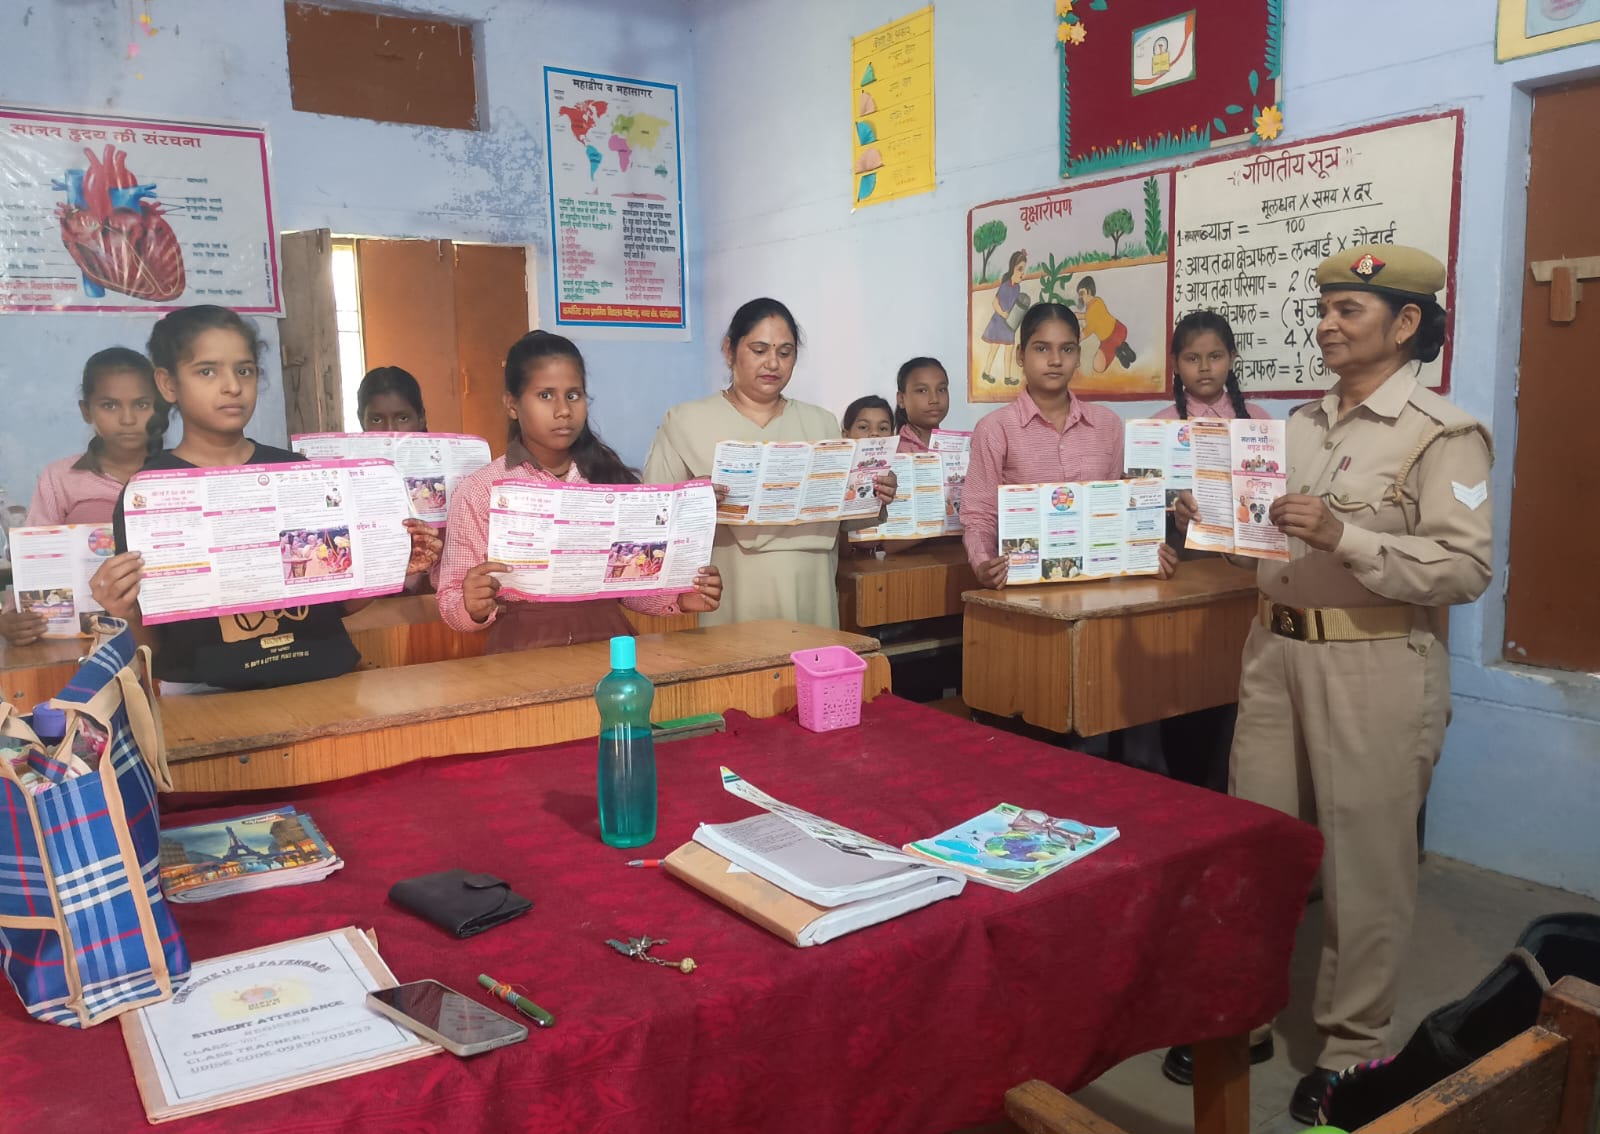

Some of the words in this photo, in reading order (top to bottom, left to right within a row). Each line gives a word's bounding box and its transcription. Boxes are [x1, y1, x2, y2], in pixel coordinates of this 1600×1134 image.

[572, 78, 603, 91] महाद्वीप
[606, 84, 613, 92] व
[616, 85, 653, 98] महासागर
[67, 127, 106, 143] हृदय
[112, 128, 136, 144] की
[143, 130, 202, 148] संरचना
[1242, 150, 1306, 184] गणितीय
[1308, 146, 1341, 179] सूत्र
[1261, 195, 1297, 219] मूलधन
[1312, 188, 1340, 209] समय
[1353, 182, 1373, 202] दर
[1019, 197, 1073, 231] वृक्षारोपण
[1200, 221, 1235, 241] ब्याज
[1285, 217, 1306, 234] 100
[1185, 254, 1222, 276] आयत
[1221, 252, 1235, 272] का
[1236, 245, 1279, 270] क्षेत्रफल
[1185, 280, 1220, 303] आयत
[1219, 278, 1233, 300] का
[1233, 271, 1267, 298] परिमाप
[1284, 329, 1298, 348] 4
[191, 1021, 253, 1040] STUDENT
[256, 999, 346, 1023] ATTENDANCE
[243, 1016, 311, 1037] REGISTER
[186, 1050, 234, 1066] CLASS
